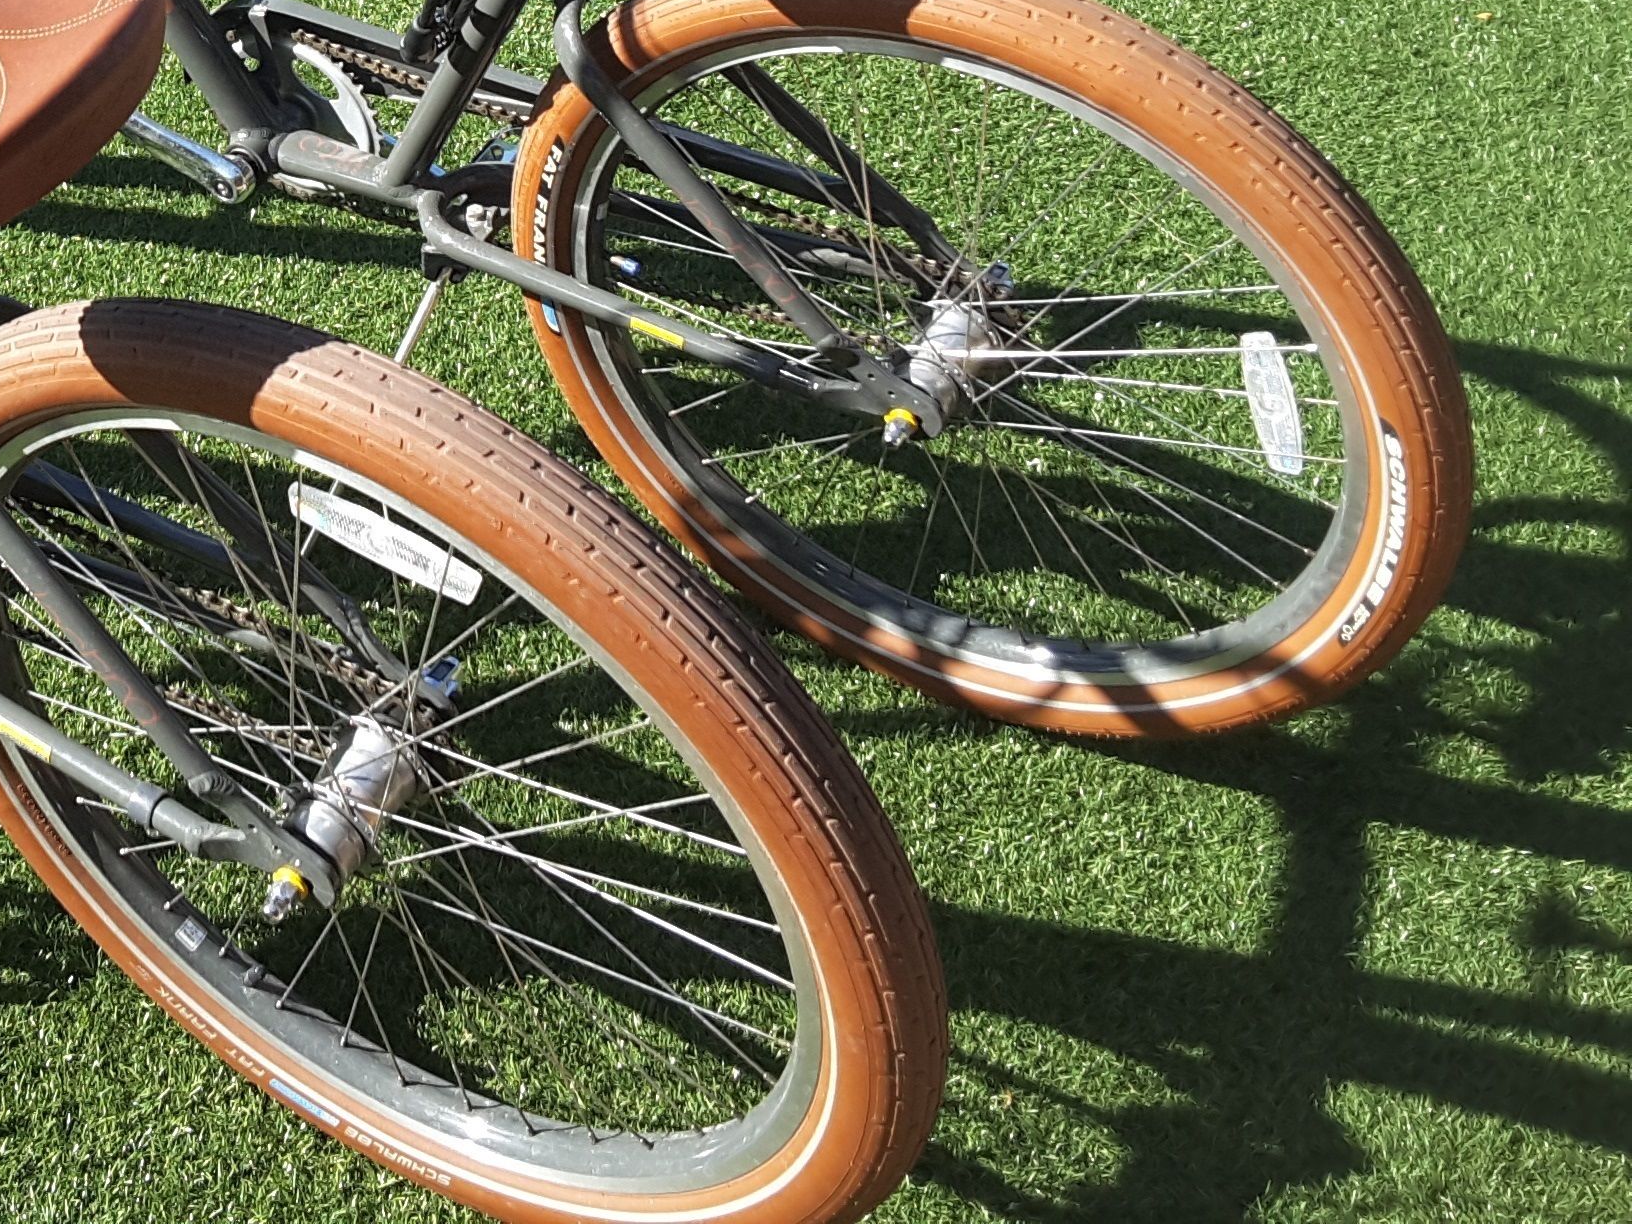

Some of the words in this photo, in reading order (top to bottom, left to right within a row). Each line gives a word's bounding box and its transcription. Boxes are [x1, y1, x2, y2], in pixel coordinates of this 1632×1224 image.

[541, 144, 563, 188] FAT
[533, 195, 548, 265] FRAN
[1366, 434, 1408, 607] SCHWALBE
[155, 986, 218, 1040] FRANK
[224, 1047, 266, 1078] FAT
[344, 1126, 452, 1187] SCHWALBE
